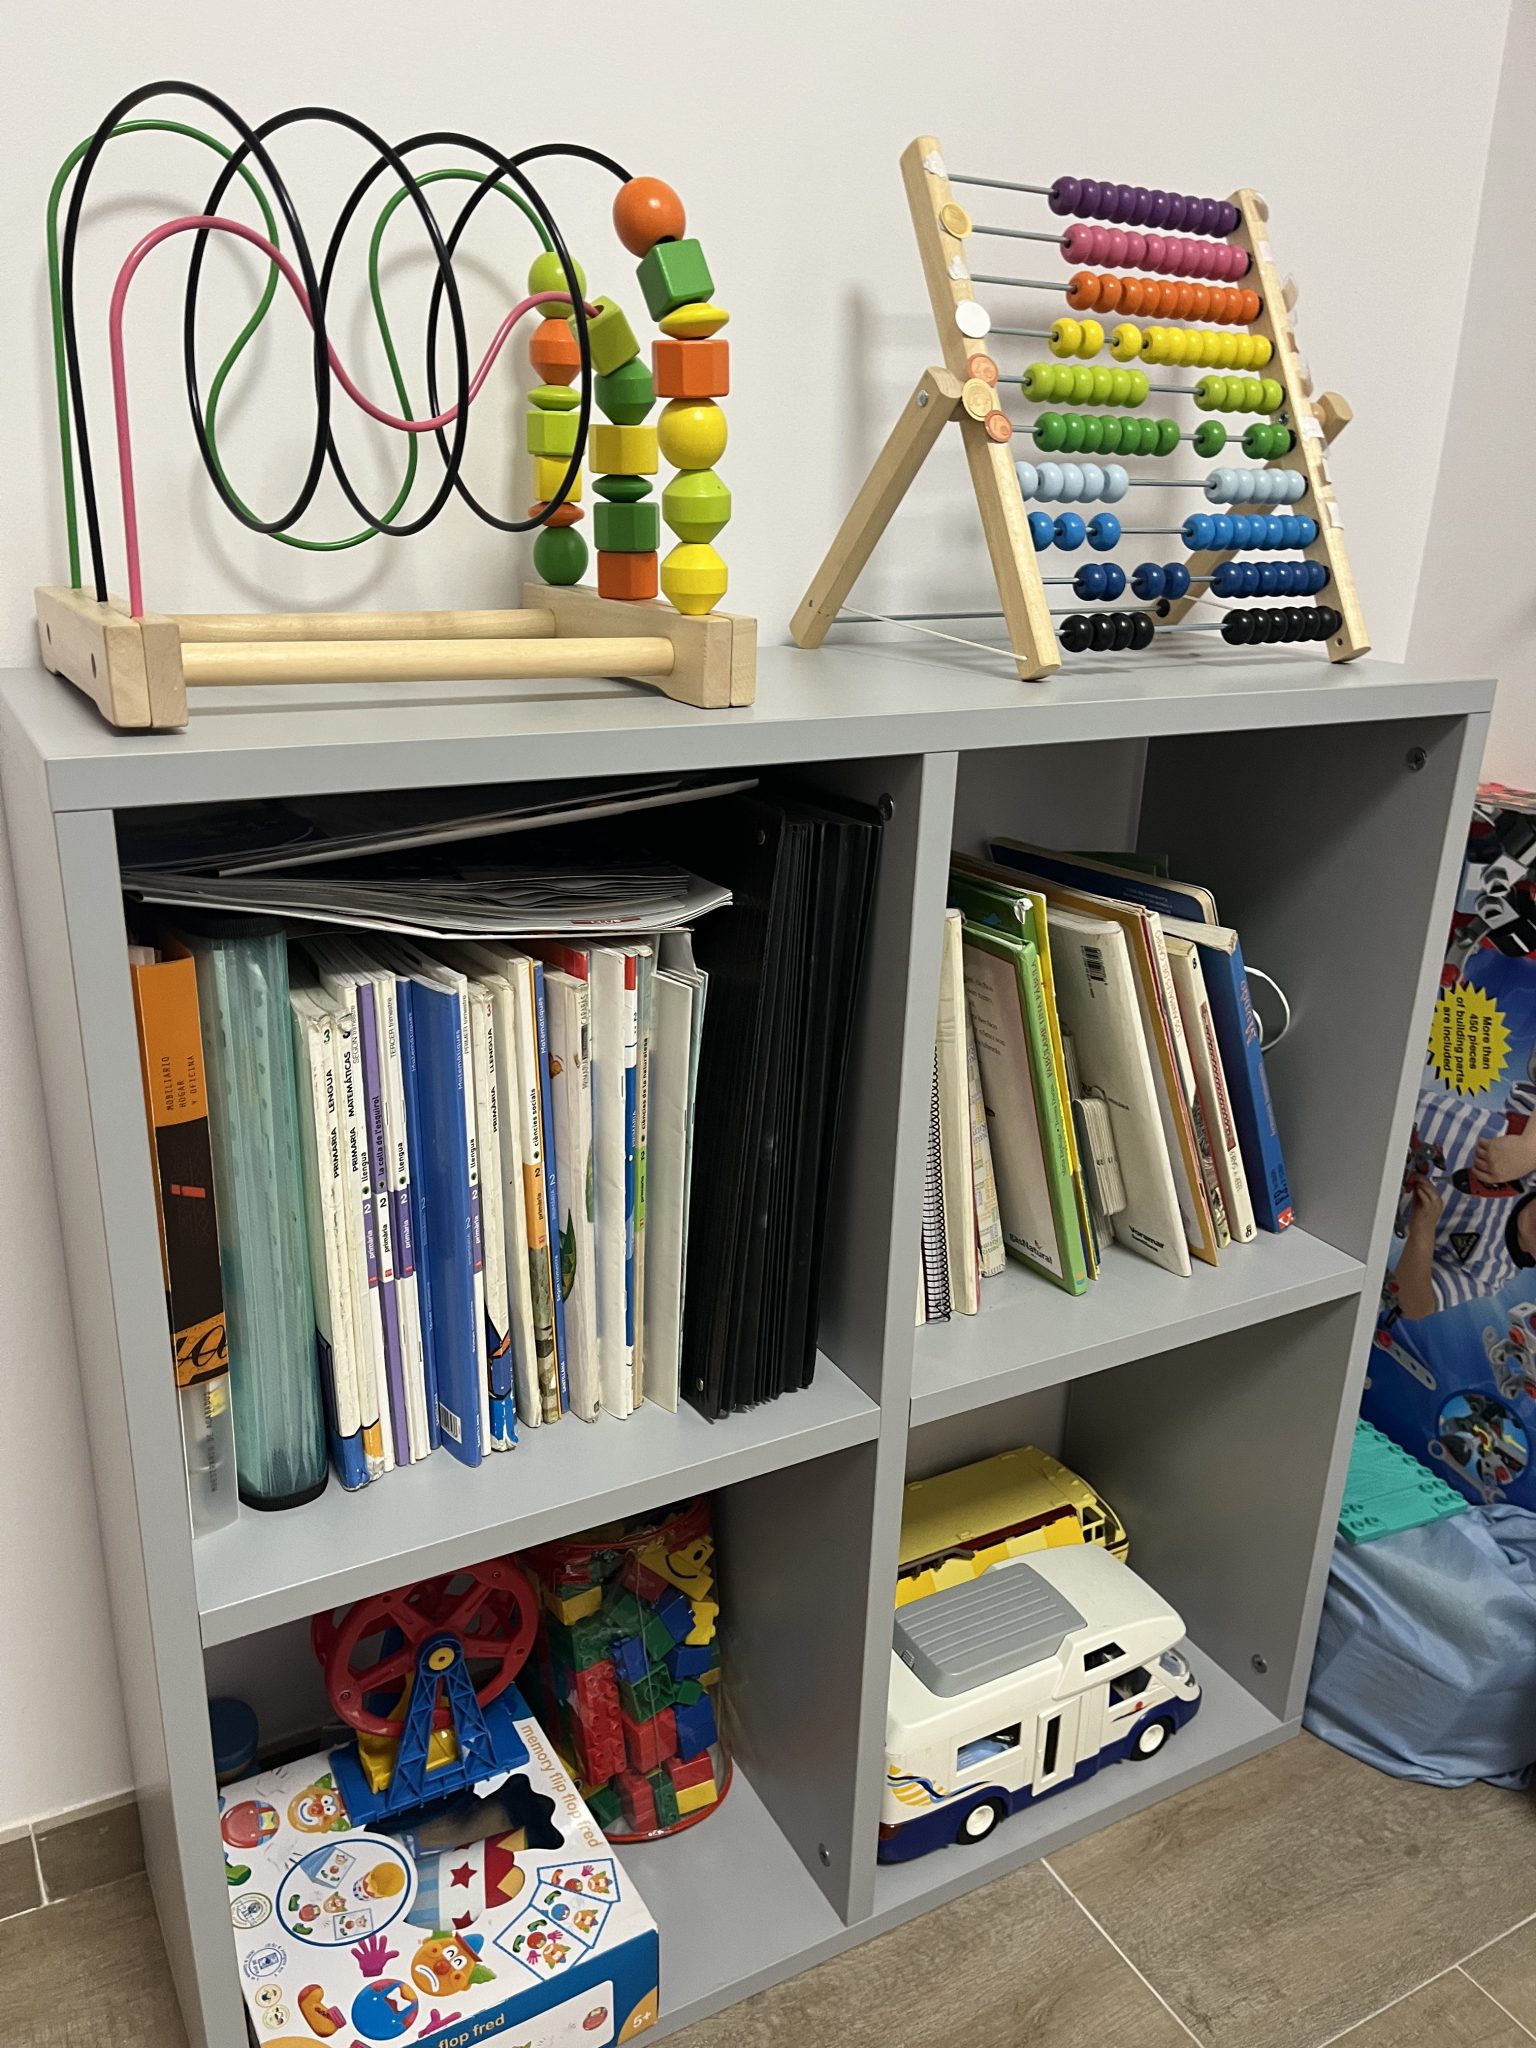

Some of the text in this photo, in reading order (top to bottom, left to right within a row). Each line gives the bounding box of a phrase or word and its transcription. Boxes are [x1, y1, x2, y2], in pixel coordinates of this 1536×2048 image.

[388, 1028, 397, 1058] TERCER
[487, 1028, 495, 1074] LLENGUA
[1443, 1006, 1453, 1071] are included
[1454, 997, 1465, 1083] of building parts
[1468, 1013, 1479, 1069] 450 pieces
[1482, 1016, 1492, 1069] More than
[161, 1055, 174, 1111] MOBILIARIO
[177, 1080, 187, 1108] HOGAR
[187, 1055, 197, 1094] OFICINA
[325, 1069, 335, 1114] LENGUA
[343, 1051, 355, 1117] MATEMÁTICAS
[330, 1127, 340, 1178] PRIMARIA
[349, 1127, 359, 1172] PRIMARIA
[372, 1095, 385, 1176] la colla de l'esquirol
[468, 1138, 477, 1169] llengua
[360, 1152, 369, 1182] llengua
[396, 1142, 406, 1173] llengua
[534, 1167, 541, 1178] 2
[363, 1203, 372, 1215] 2
[379, 1197, 387, 1208] 2
[400, 1193, 408, 1204] 2
[471, 1189, 478, 1200] 2
[521, 1725, 603, 1848] memory flip flop fred
[438, 2013, 505, 2048] flop fred
[632, 2010, 652, 2029] 5+
